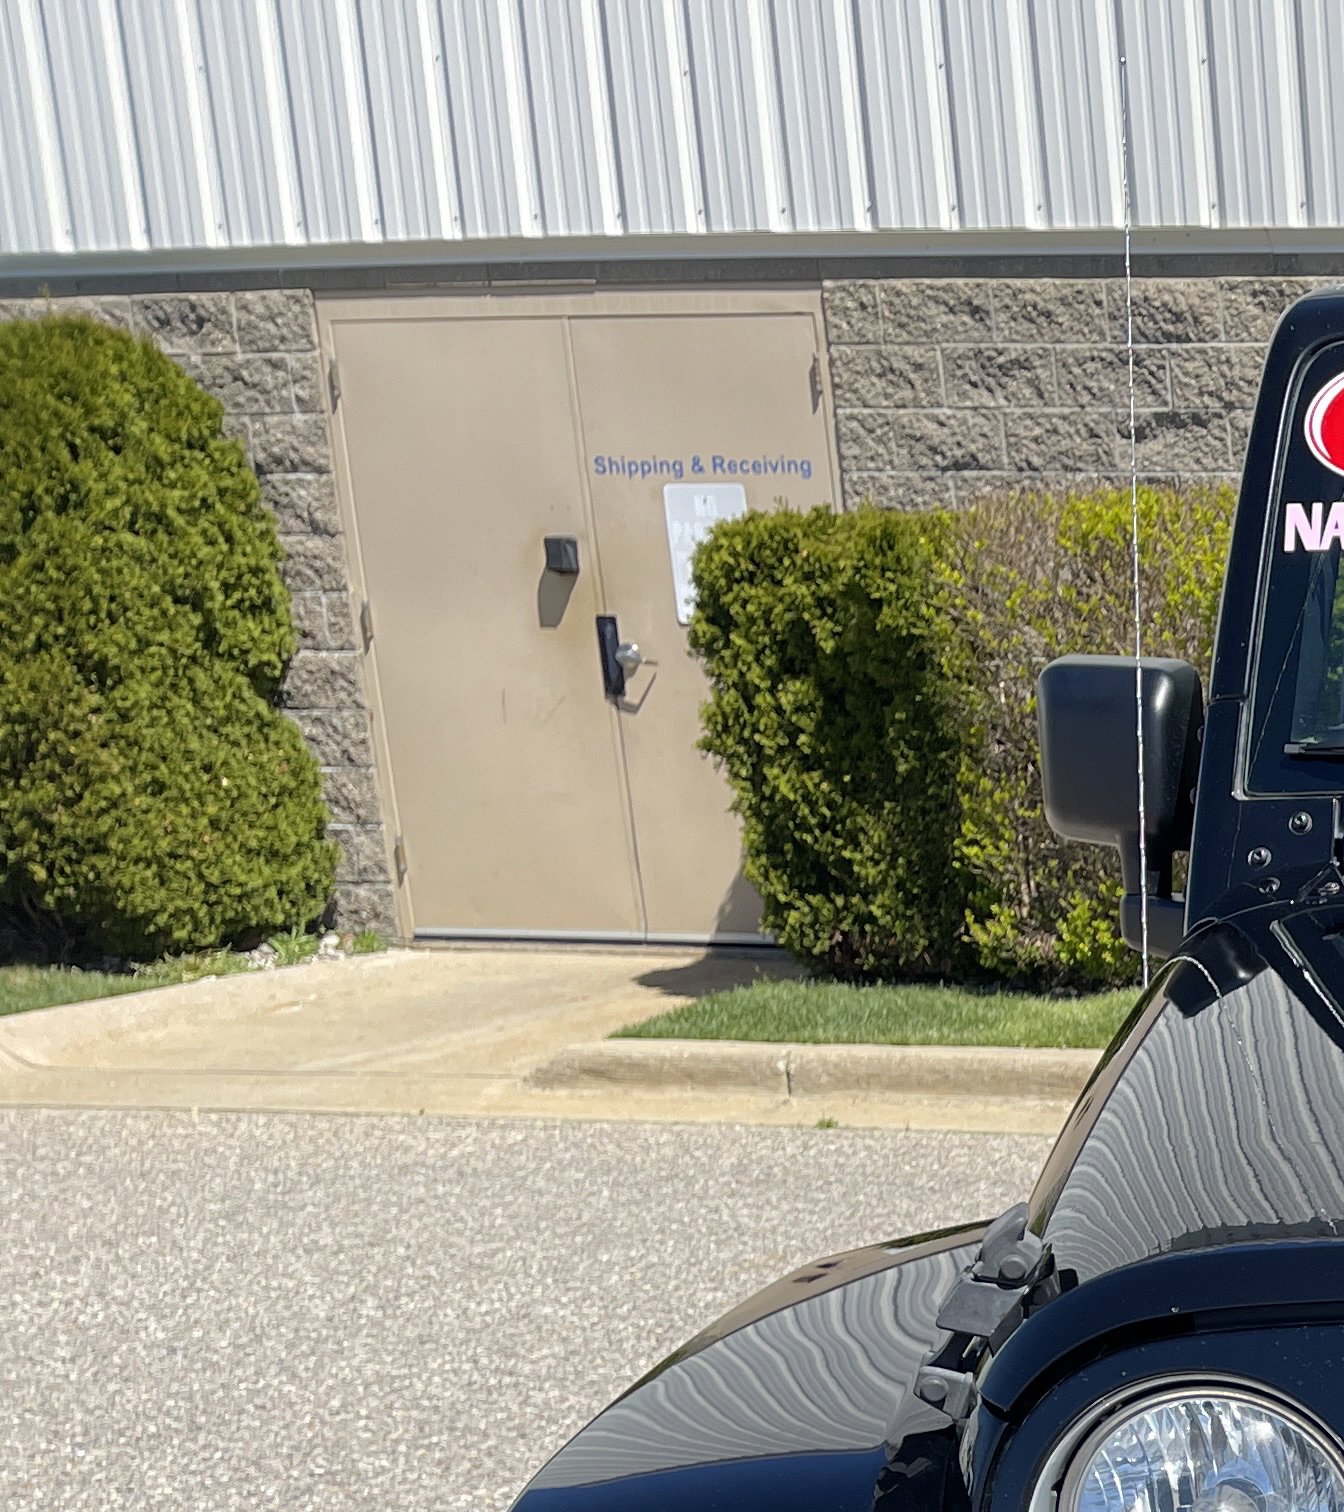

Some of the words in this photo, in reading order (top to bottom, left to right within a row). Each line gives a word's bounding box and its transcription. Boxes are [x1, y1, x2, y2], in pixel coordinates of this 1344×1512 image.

[594, 455, 683, 480] Shipping
[691, 455, 705, 474] &
[712, 455, 812, 479] Receiving
